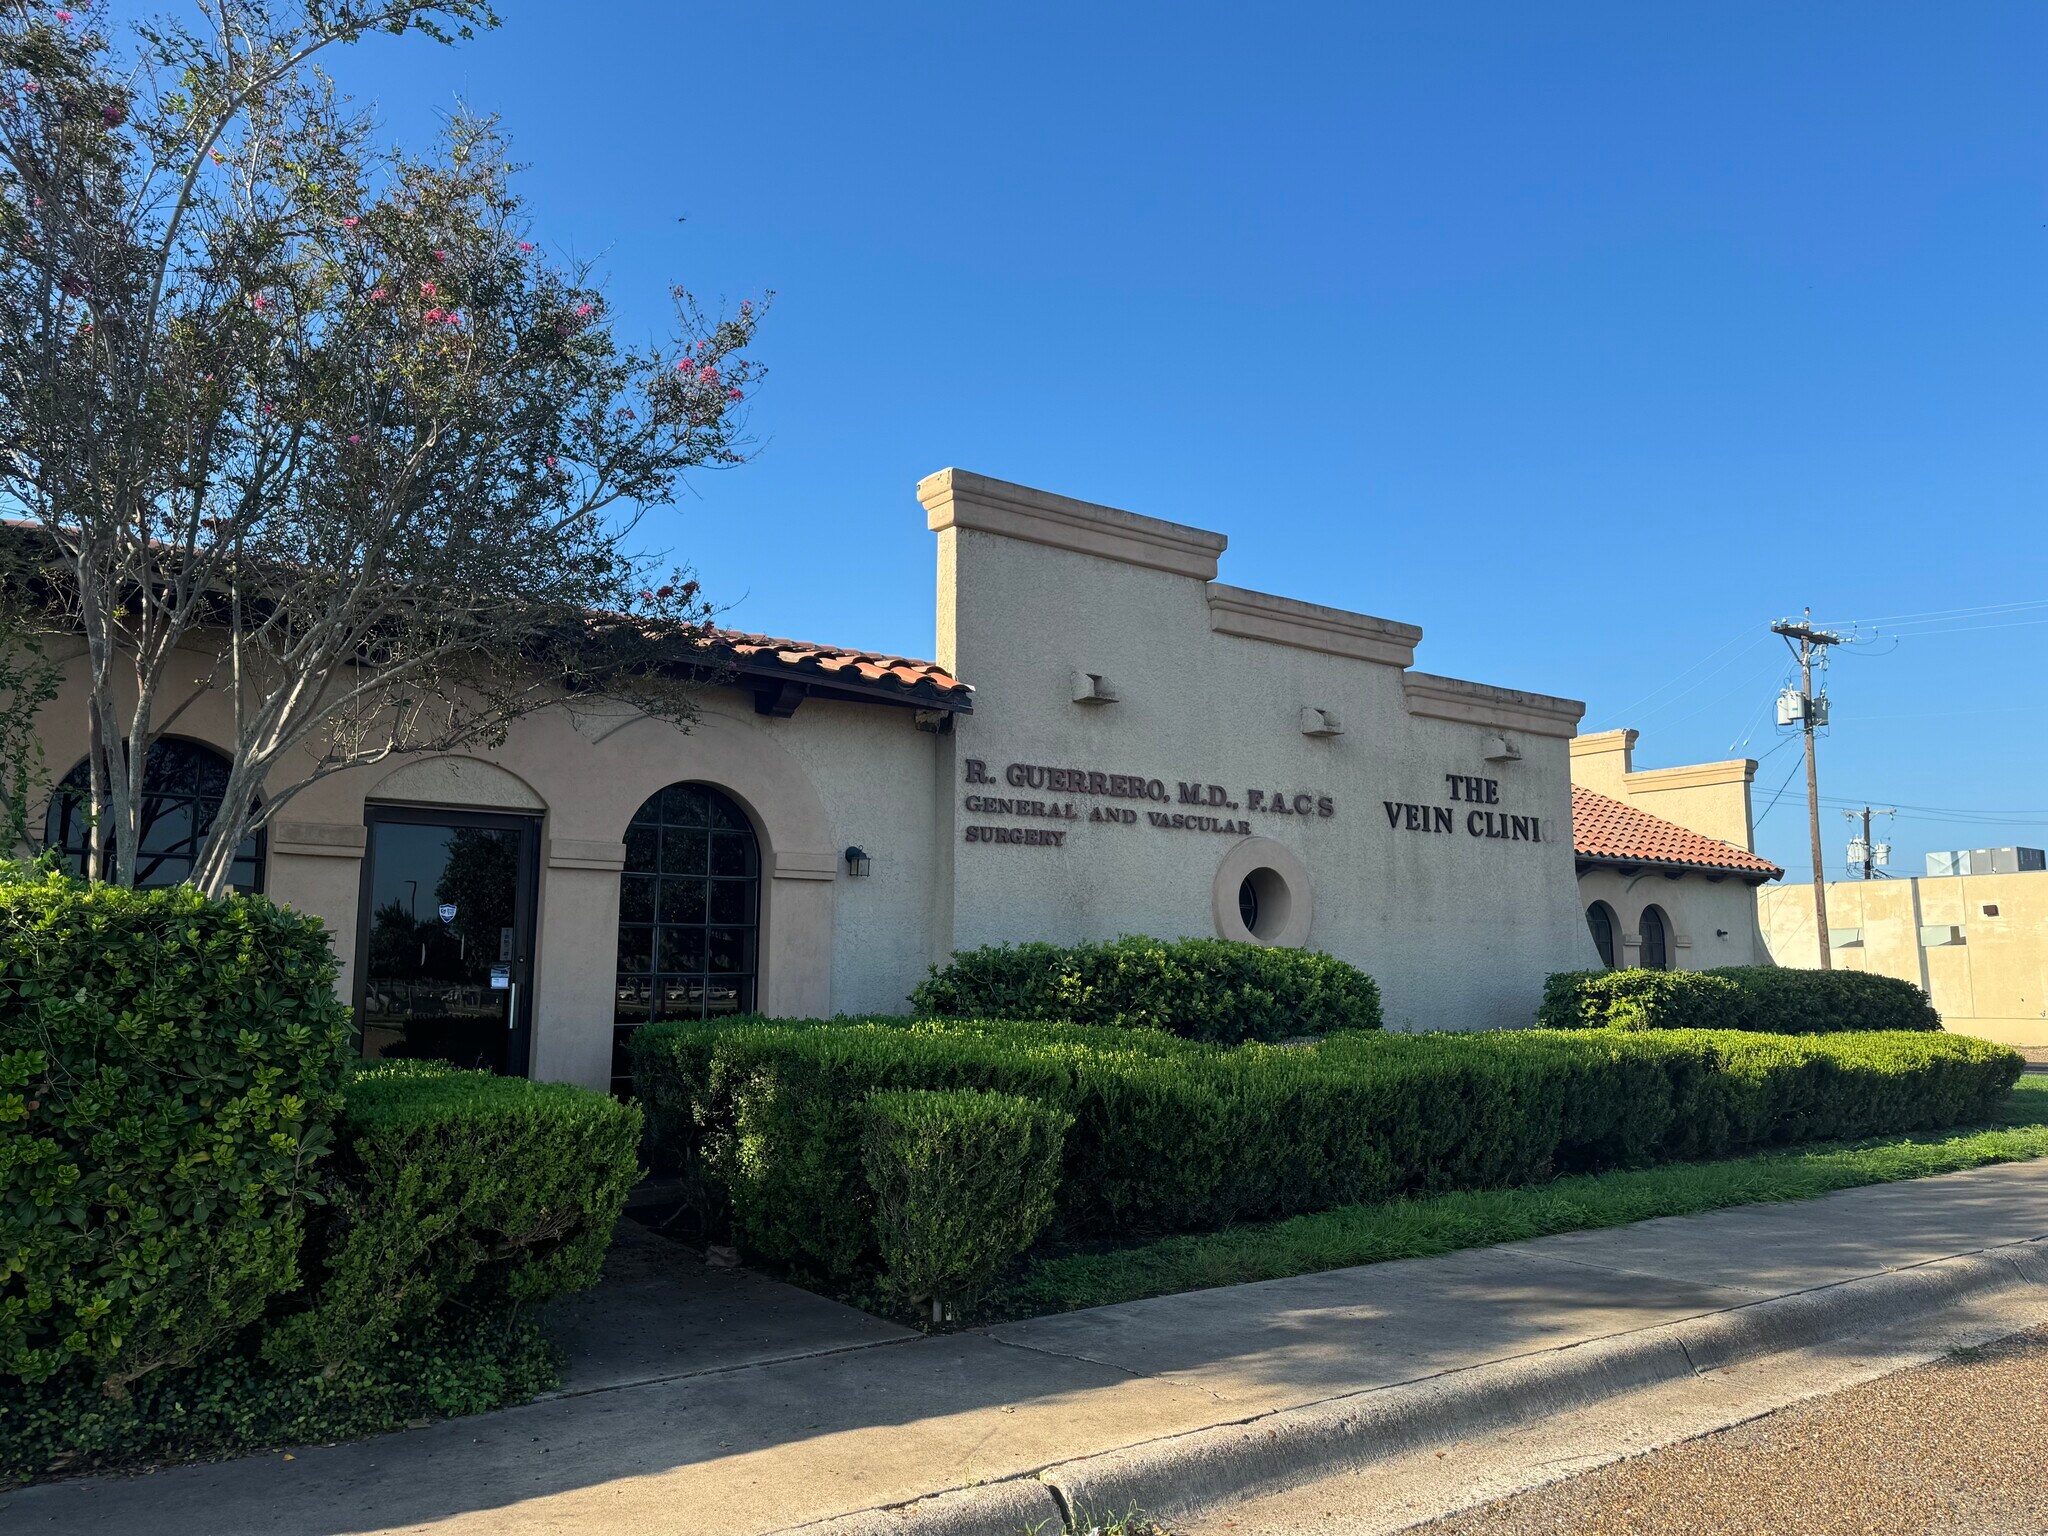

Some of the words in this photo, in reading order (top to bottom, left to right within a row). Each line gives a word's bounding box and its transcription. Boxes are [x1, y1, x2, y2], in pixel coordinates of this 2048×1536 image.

[965, 759, 997, 784] R.
[1006, 763, 1171, 803] GUERRERO,
[1446, 774, 1500, 805] THE
[965, 795, 1078, 820] GENERAL
[1089, 806, 1138, 824] AND
[1147, 811, 1252, 836] VASCULAR
[965, 825, 1067, 847] SURGERY
[1383, 801, 1454, 834] VEIN
[1467, 810, 1556, 845] CLINI
